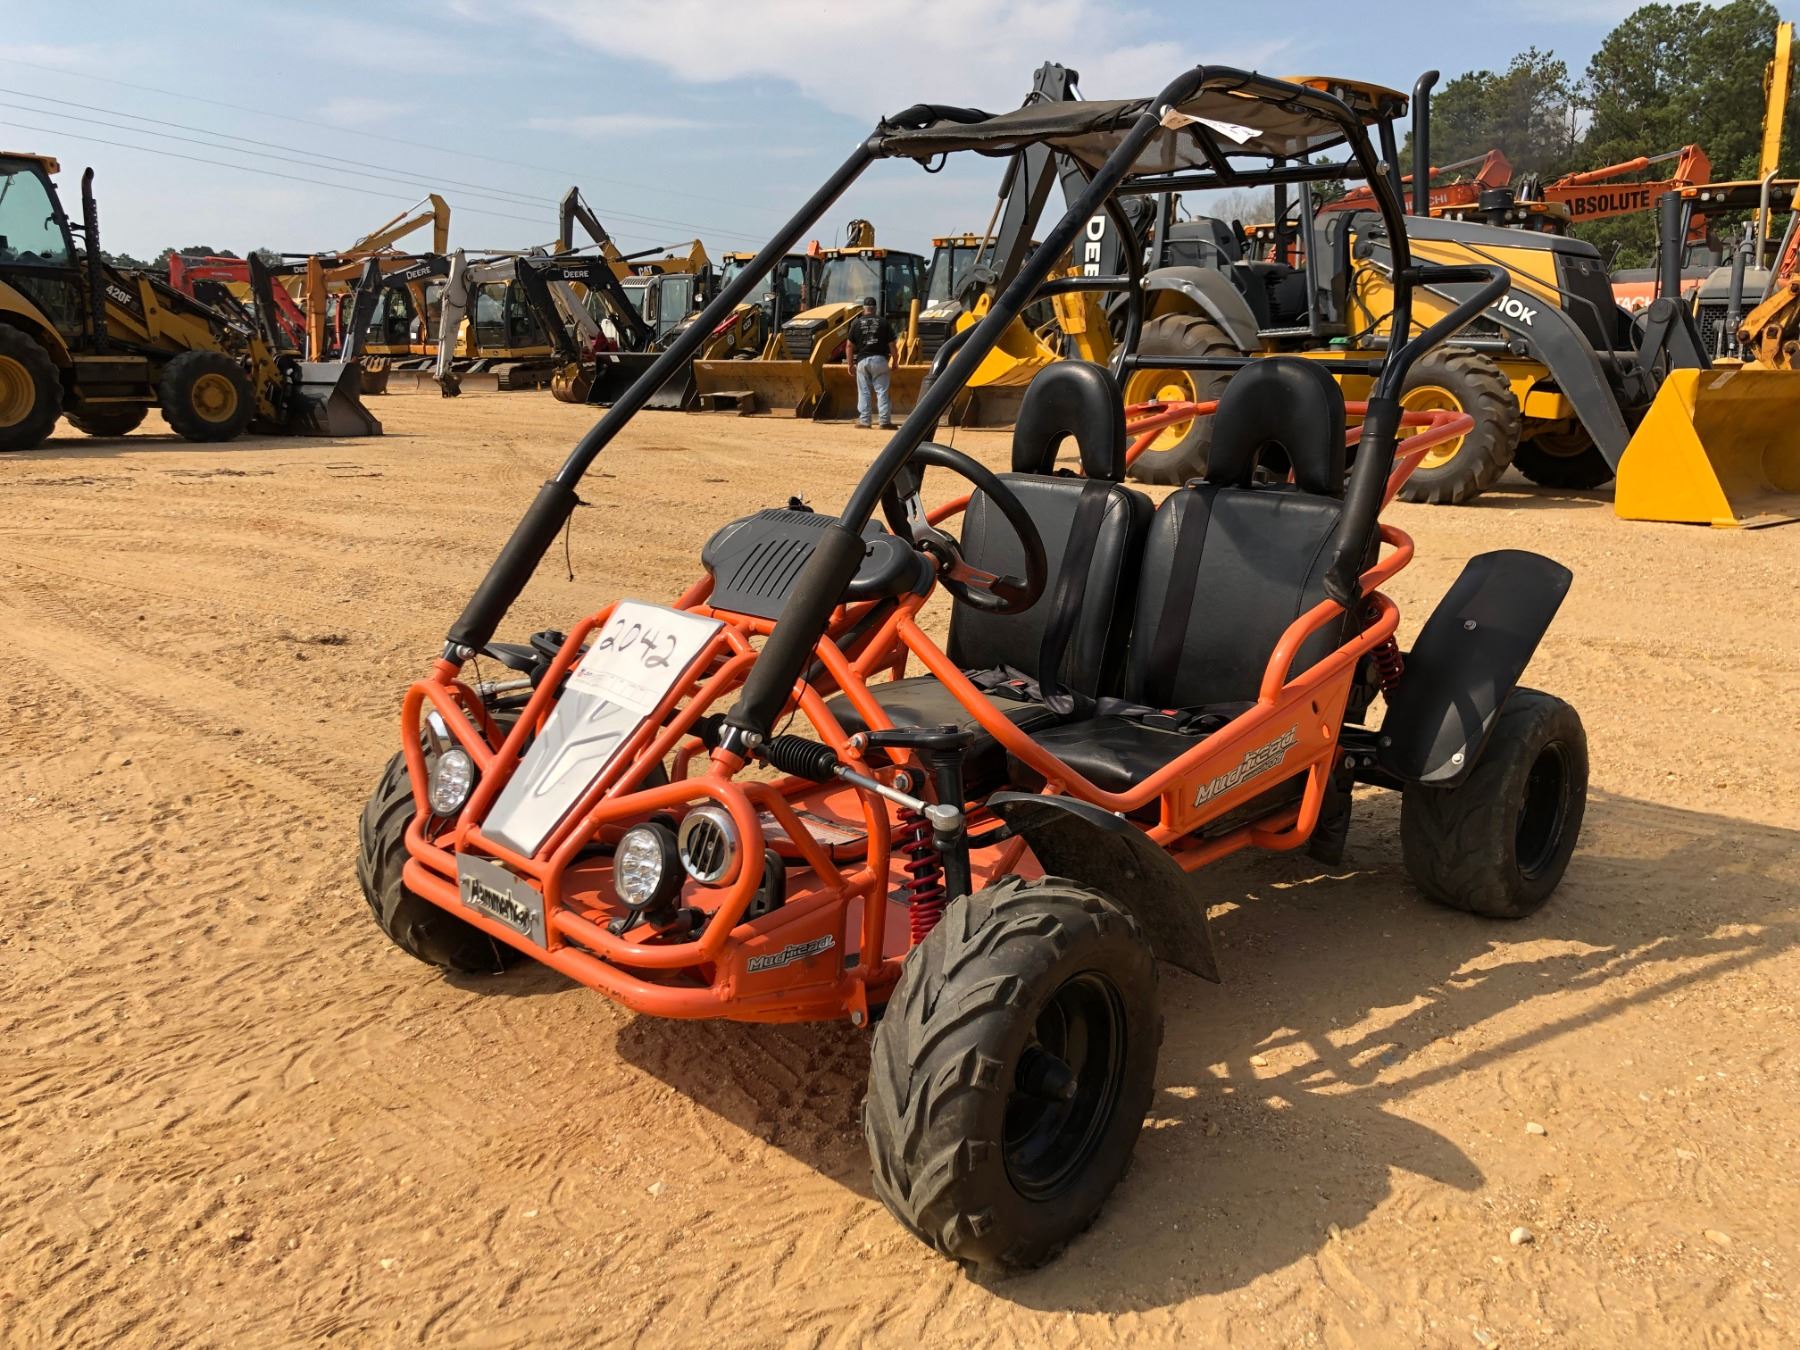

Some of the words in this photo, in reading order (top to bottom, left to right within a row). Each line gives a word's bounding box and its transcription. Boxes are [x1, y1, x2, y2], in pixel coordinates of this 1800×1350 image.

[1565, 190, 1649, 216] ABSOLUTE
[406, 266, 431, 280] DEERE
[563, 270, 589, 278] DEERE
[105, 285, 132, 304] 420F
[1490, 295, 1538, 326] 10K
[599, 618, 677, 669] 2042
[747, 934, 836, 974] Mudhead
